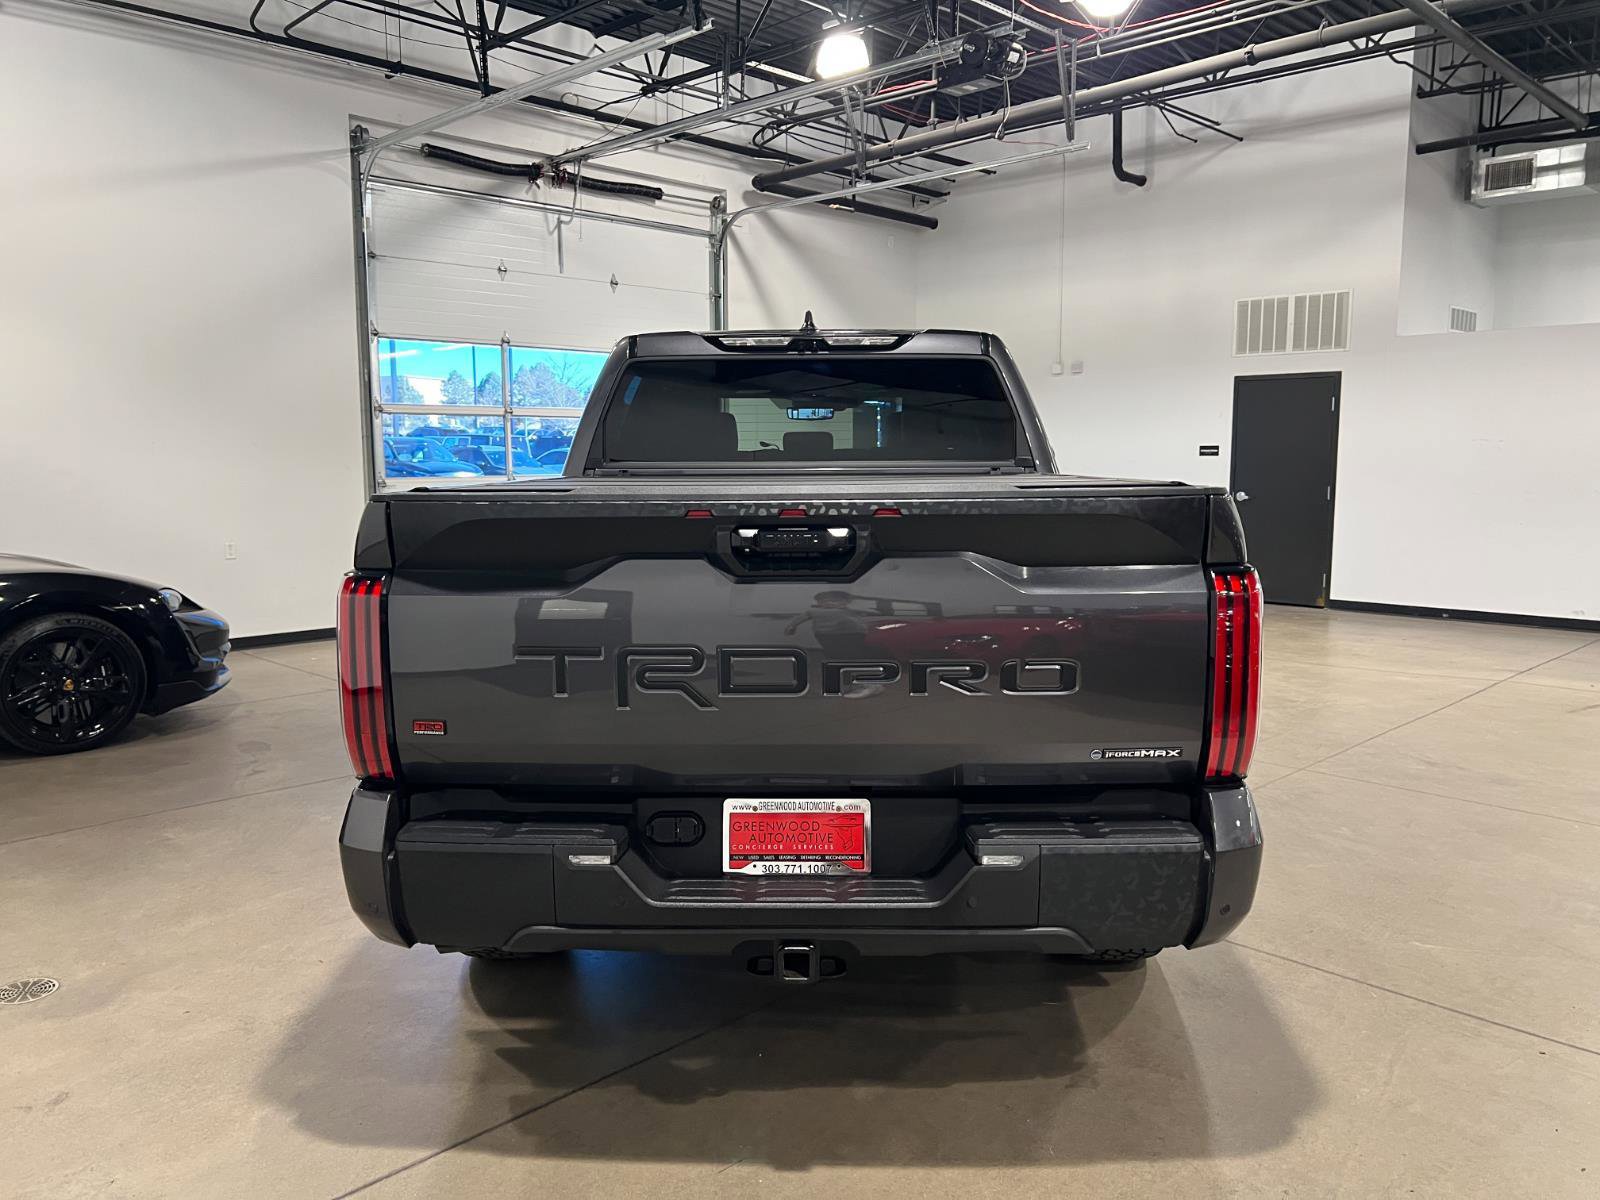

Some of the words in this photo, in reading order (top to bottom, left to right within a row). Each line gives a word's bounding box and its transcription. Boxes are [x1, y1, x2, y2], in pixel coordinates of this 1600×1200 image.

[513, 643, 810, 711] TRD
[820, 658, 1081, 698] PRO
[1141, 749, 1181, 758] MAX
[732, 821, 820, 832] GREENWOOD
[749, 832, 834, 844] AUTOMOTIVE
